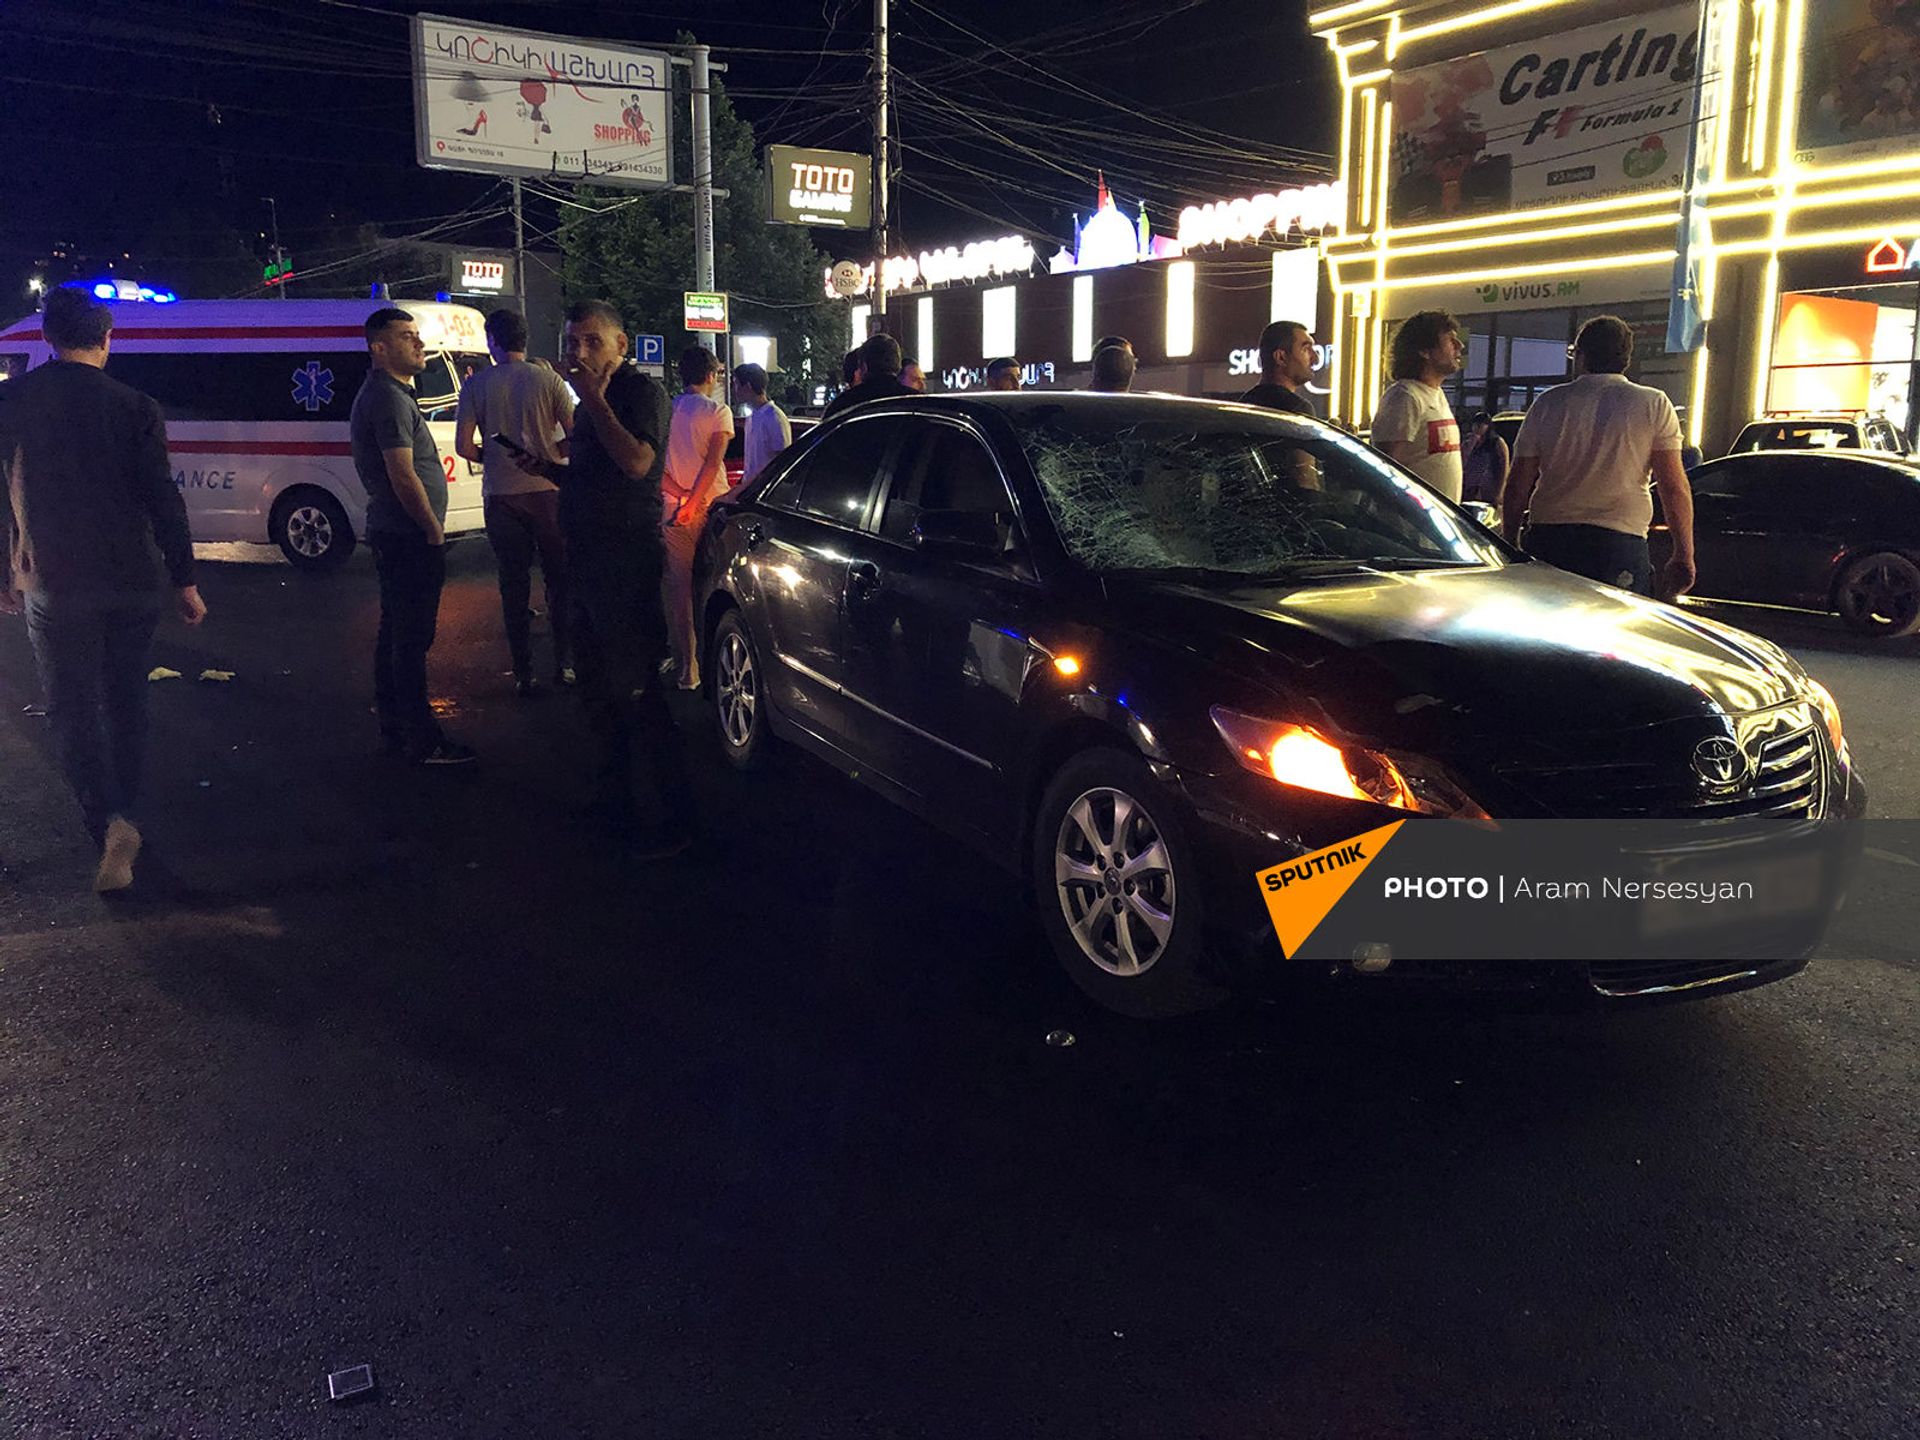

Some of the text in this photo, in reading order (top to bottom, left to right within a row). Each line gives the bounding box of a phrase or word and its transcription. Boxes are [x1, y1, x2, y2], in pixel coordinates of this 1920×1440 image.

[1580, 105, 1664, 132] Formula
[594, 123, 651, 146] SHOPPING
[790, 162, 855, 194] TOTO
[461, 260, 504, 278] TOTO
[835, 277, 860, 288] HSBC
[643, 338, 659, 361] P
[443, 455, 457, 483] 2
